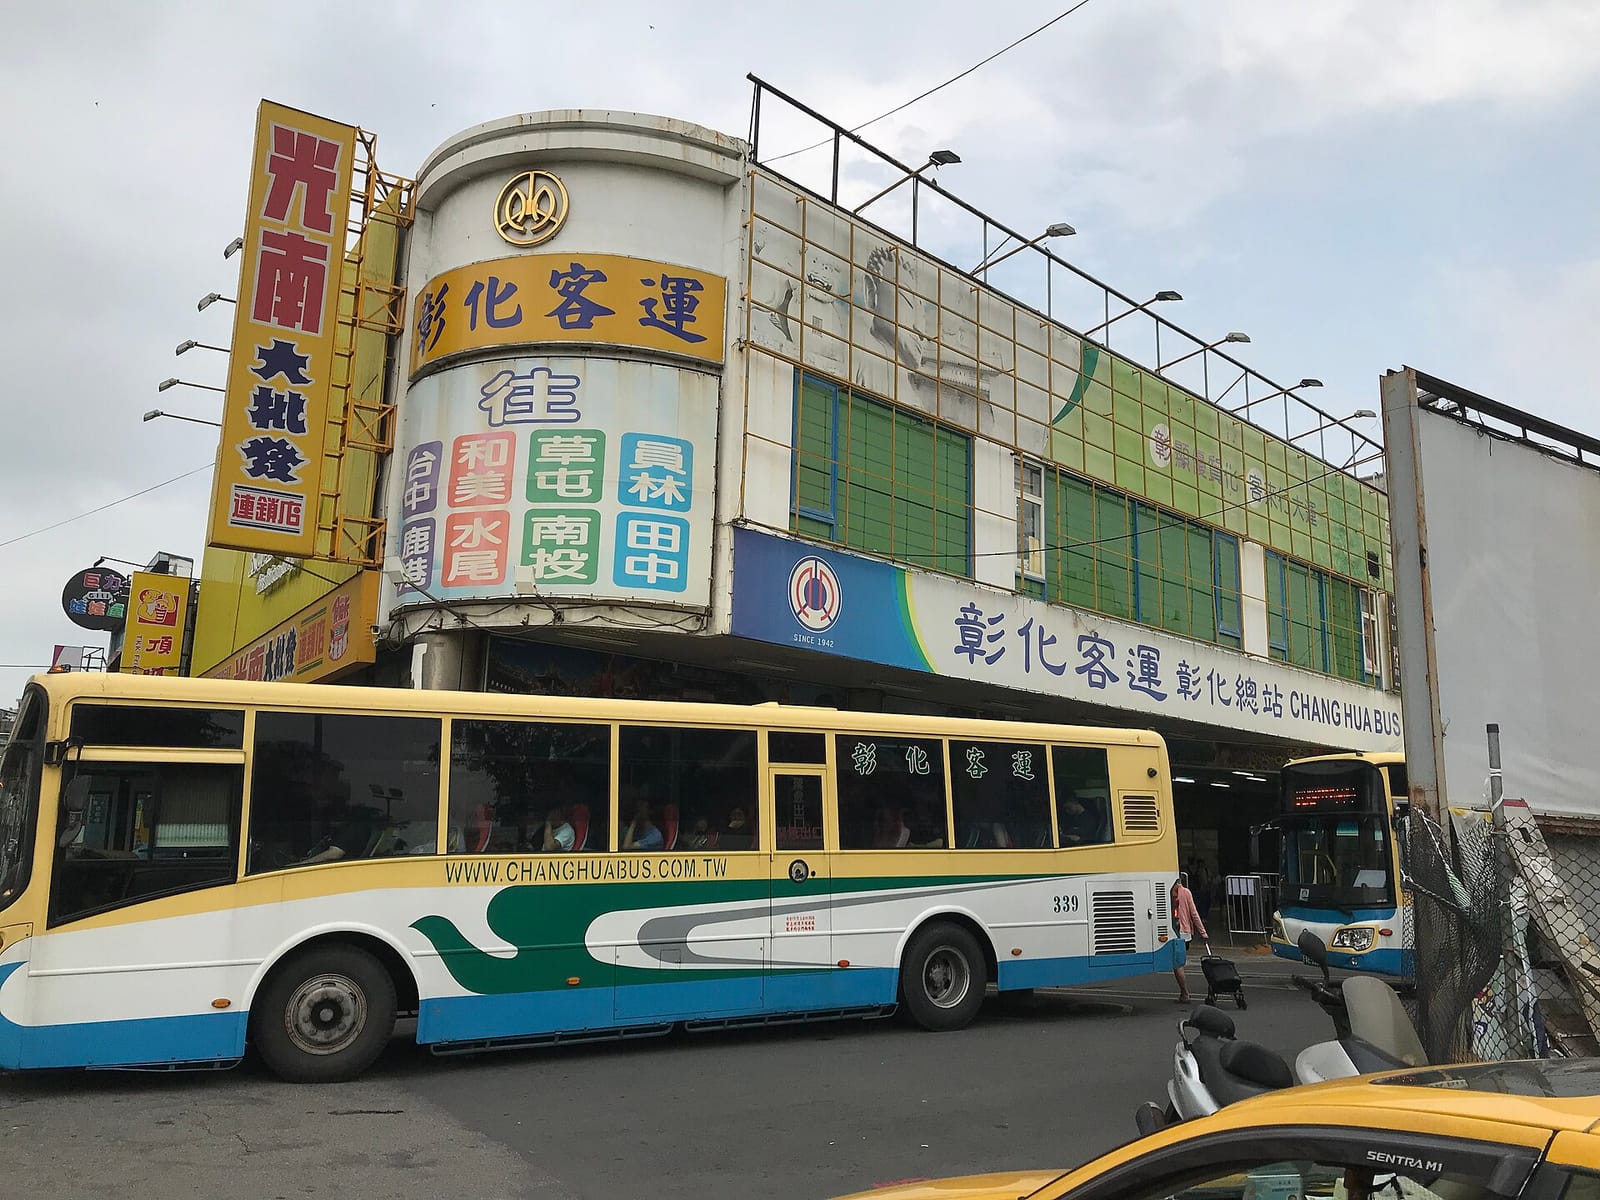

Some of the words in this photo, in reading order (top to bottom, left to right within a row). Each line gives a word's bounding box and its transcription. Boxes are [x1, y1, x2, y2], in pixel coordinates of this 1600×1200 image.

[416, 262, 707, 354] 彰化客運
[479, 367, 581, 427] 往
[404, 451, 436, 511] 台中
[454, 438, 508, 503] 和美
[535, 435, 597, 498] 草屯
[628, 440, 687, 505] 員林
[232, 491, 303, 527] 連鎖店
[447, 517, 502, 583] 水尾
[531, 514, 592, 580] 南投
[625, 521, 680, 583] 田中
[793, 633, 815, 645] SINCE
[817, 638, 834, 648] 1942
[954, 602, 1168, 703] 彰化客運
[1176, 659, 1284, 719] 彰化總站
[1374, 709, 1401, 737] BUS
[851, 741, 1035, 782] 彰化客運
[446, 857, 728, 884] WWW.CHANGHUABUS.COM.TW
[1053, 894, 1079, 914] 339
[1366, 1150, 1423, 1169] SENTRA
